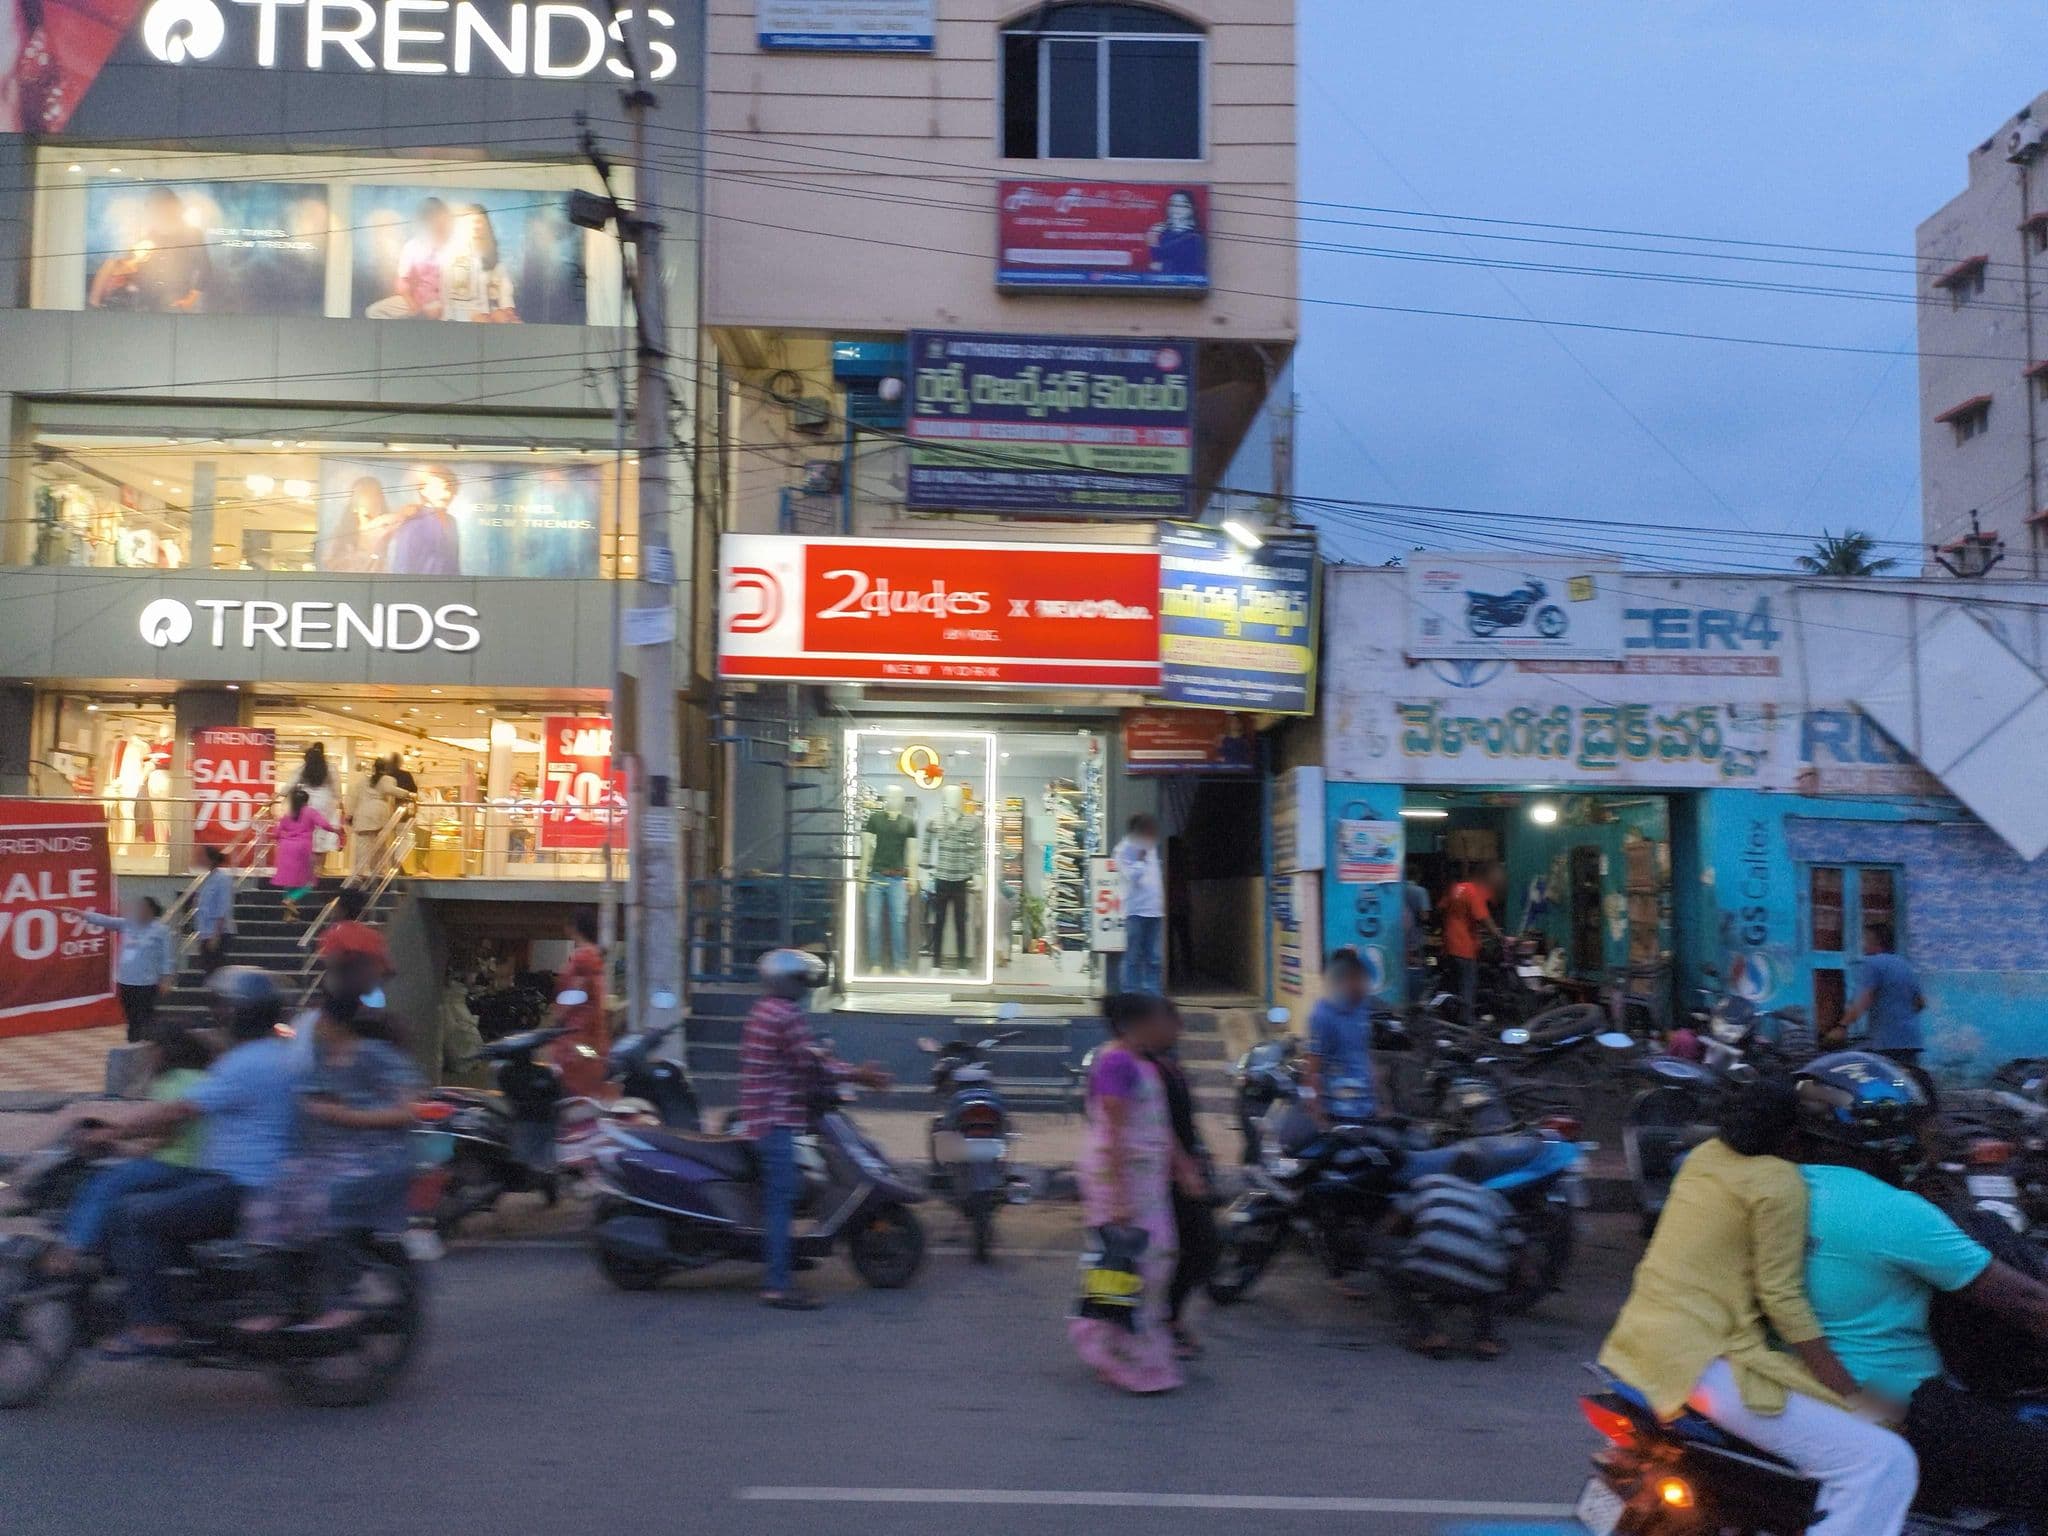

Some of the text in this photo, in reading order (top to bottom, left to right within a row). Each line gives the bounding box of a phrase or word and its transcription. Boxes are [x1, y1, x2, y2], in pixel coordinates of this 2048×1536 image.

[231, 0, 677, 80] TRENDS
[195, 599, 480, 651] TRENDS
[201, 731, 276, 746] TRENDS
[193, 759, 275, 785] SALE
[0, 836, 92, 854] RENDS
[2, 869, 98, 904] ALE
